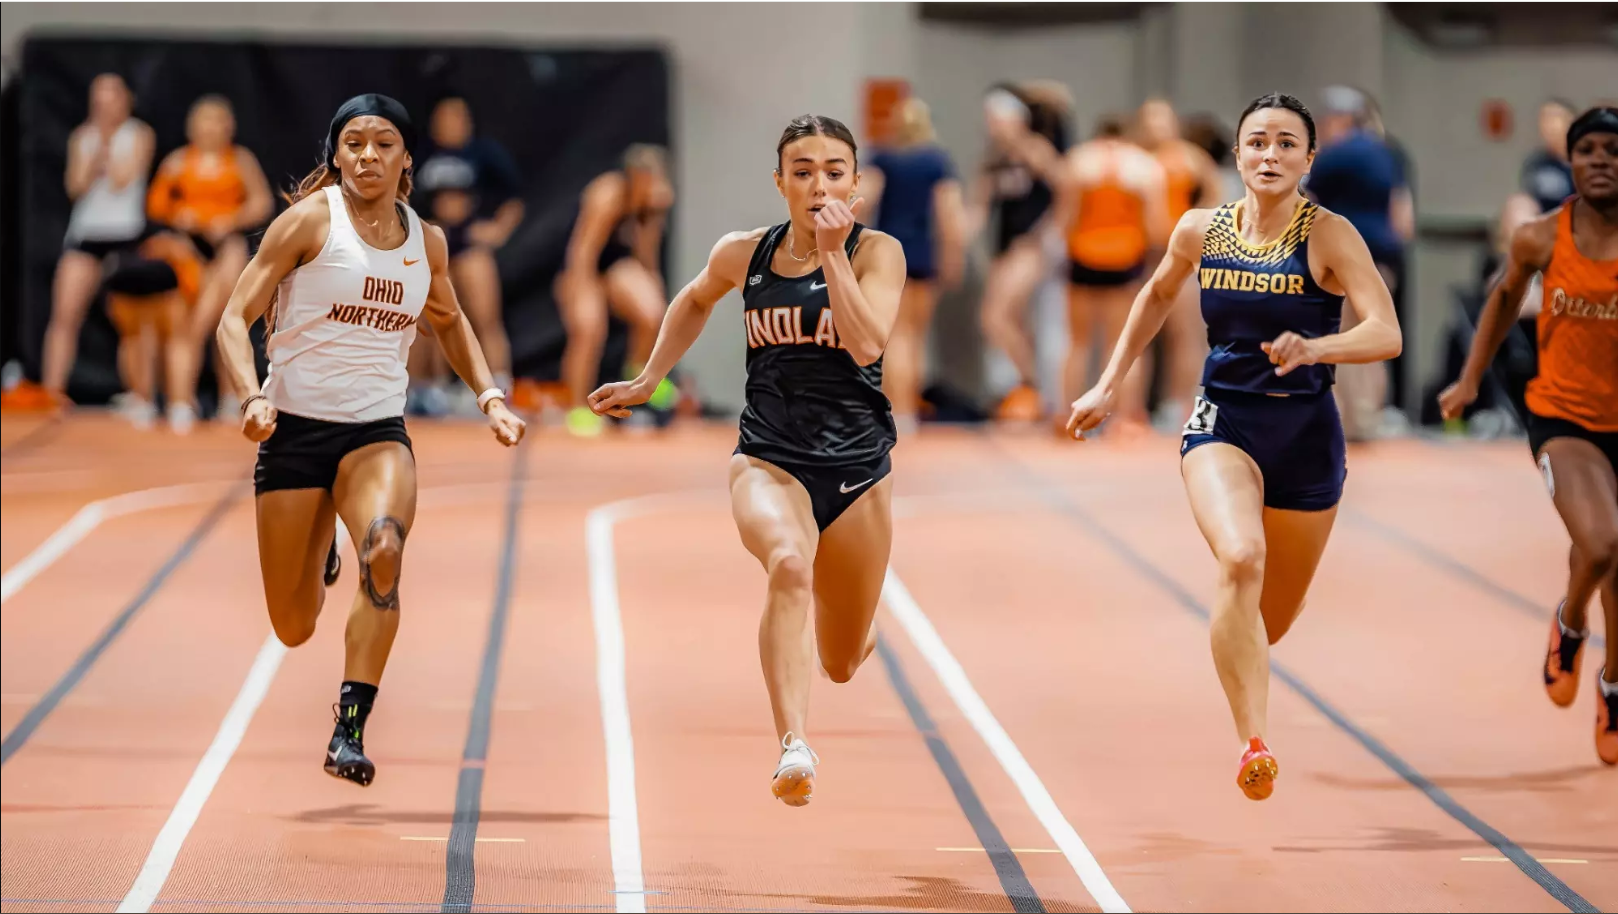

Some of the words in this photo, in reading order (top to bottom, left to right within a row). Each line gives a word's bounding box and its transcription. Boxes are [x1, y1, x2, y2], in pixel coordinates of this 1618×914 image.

[363, 276, 404, 306] OHIO
[1200, 267, 1304, 294] WINDSOR
[745, 306, 846, 349] INDLA
